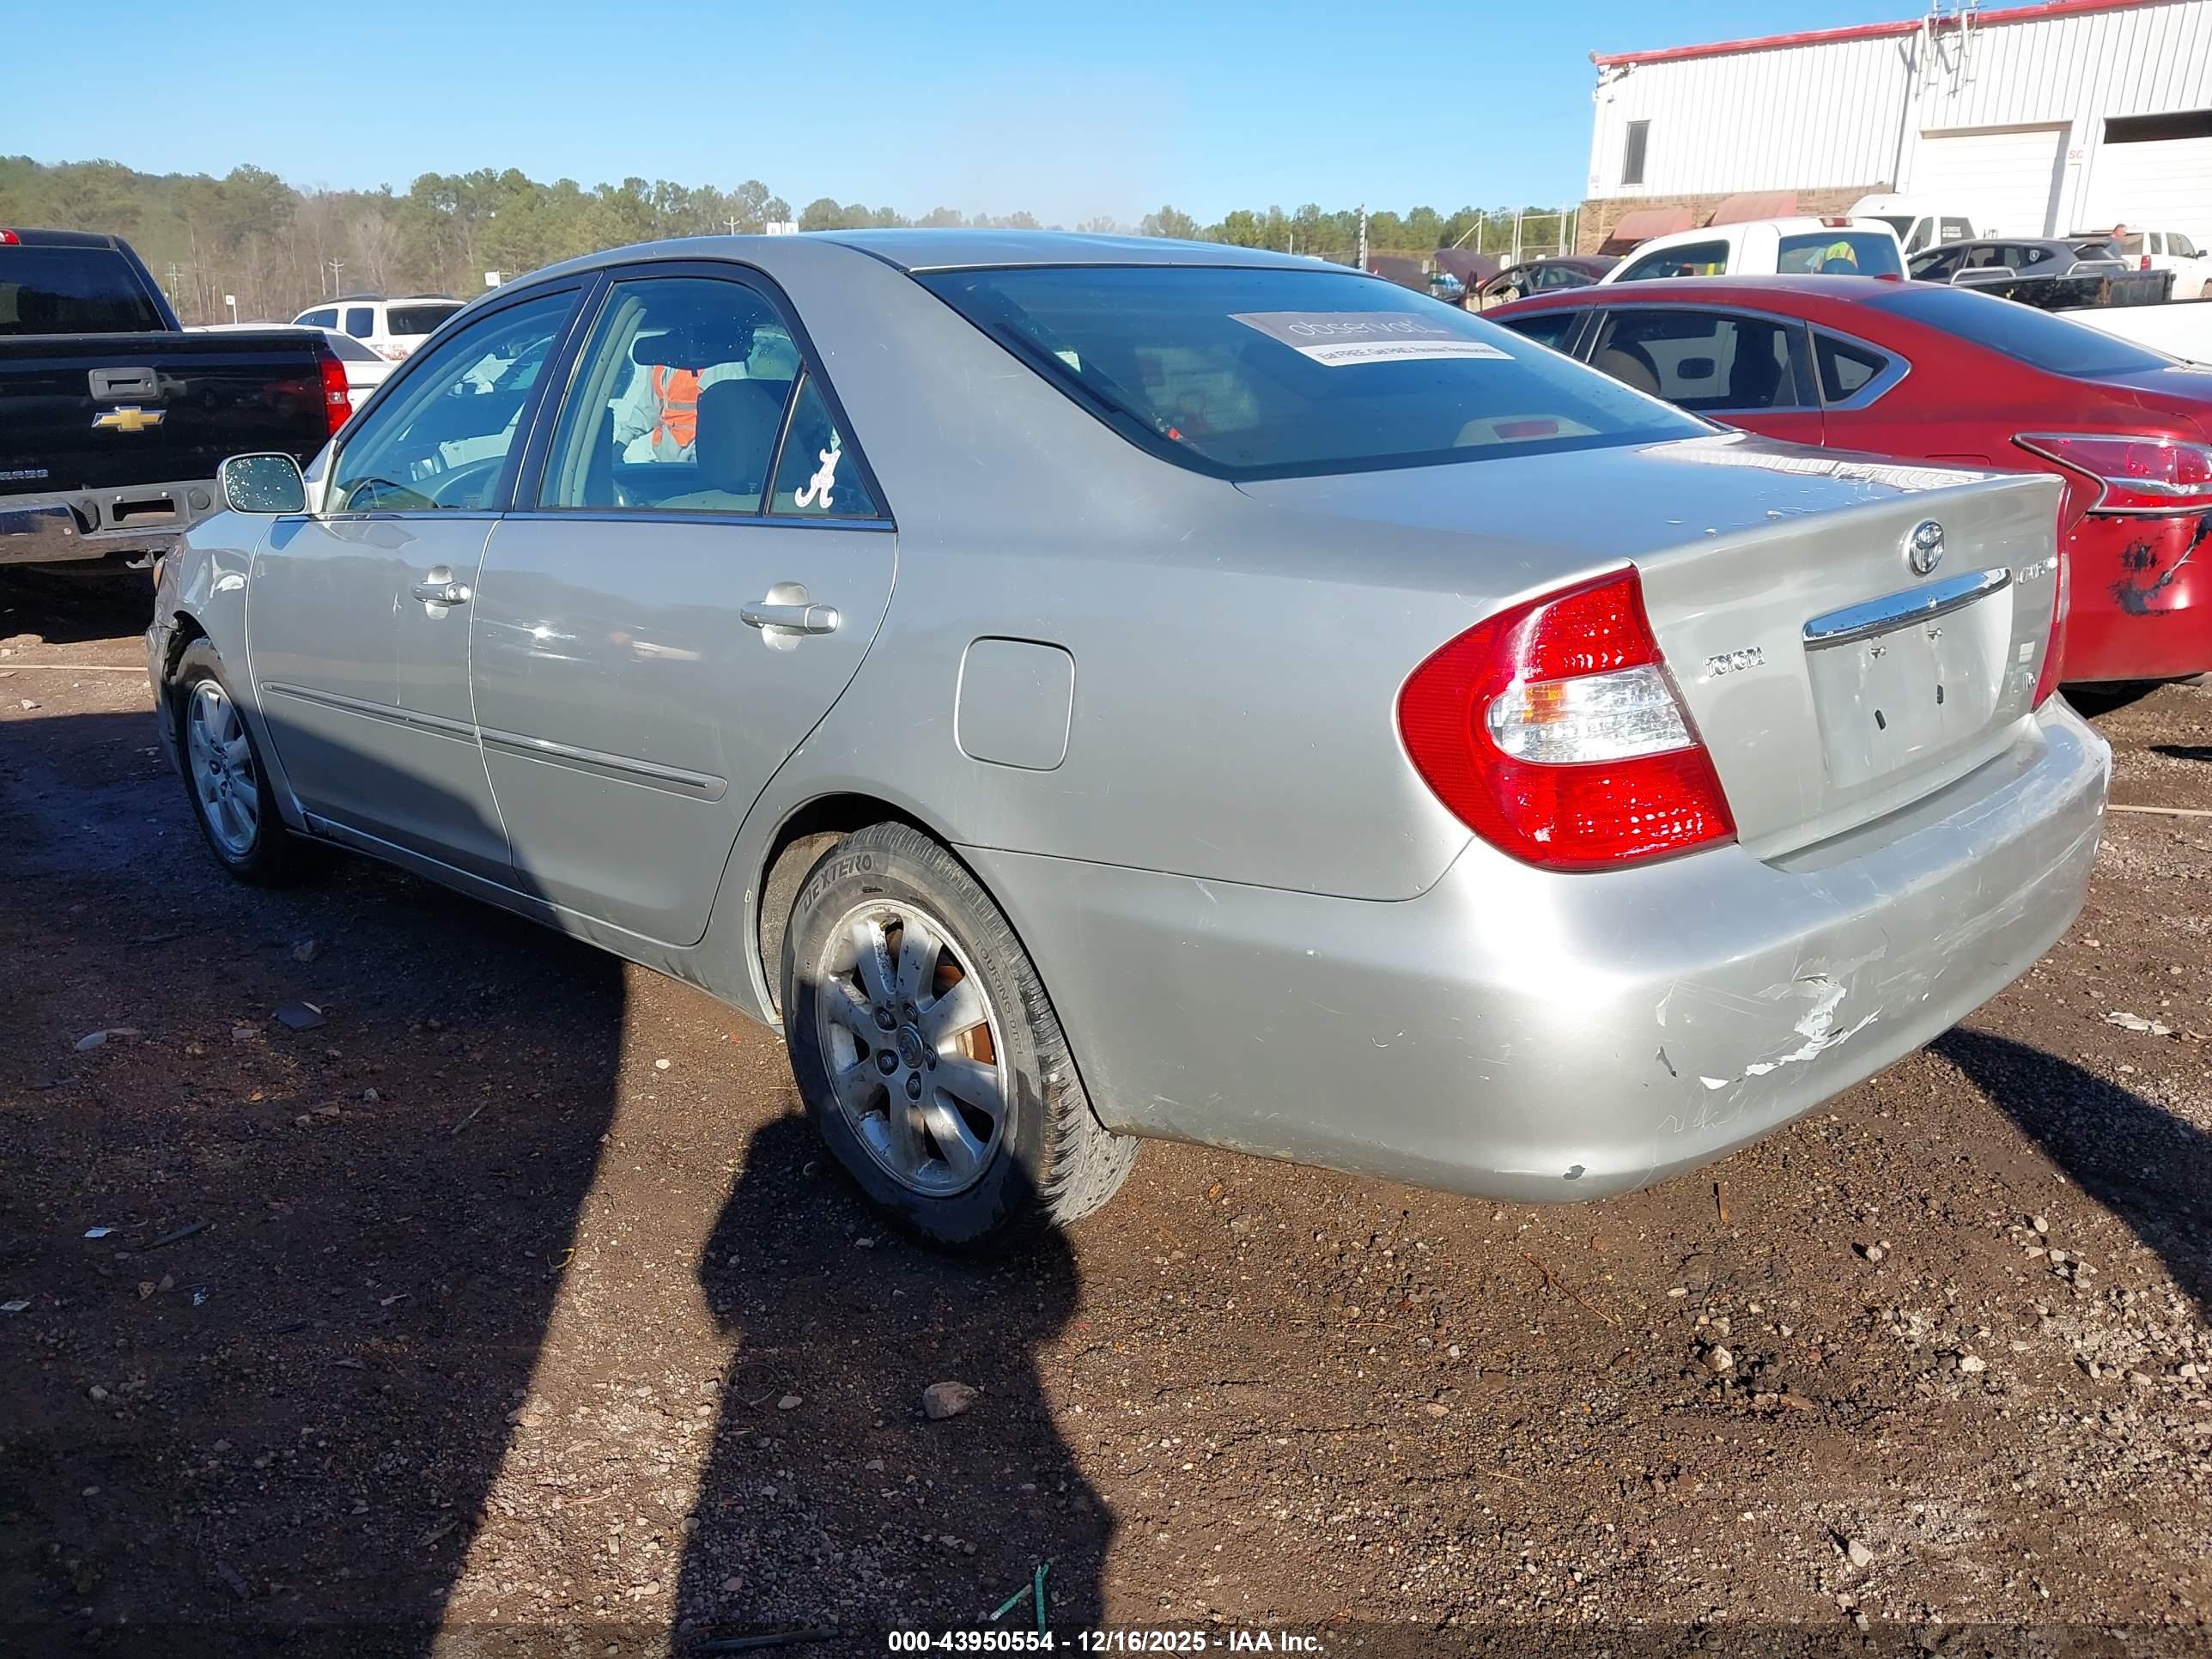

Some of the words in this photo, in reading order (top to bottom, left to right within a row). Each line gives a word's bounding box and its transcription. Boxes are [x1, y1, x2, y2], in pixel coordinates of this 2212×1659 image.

[1704, 645, 1766, 678] TOYOTA
[799, 854, 873, 915] DEXTERO
[975, 936, 1014, 1014] TOURING
